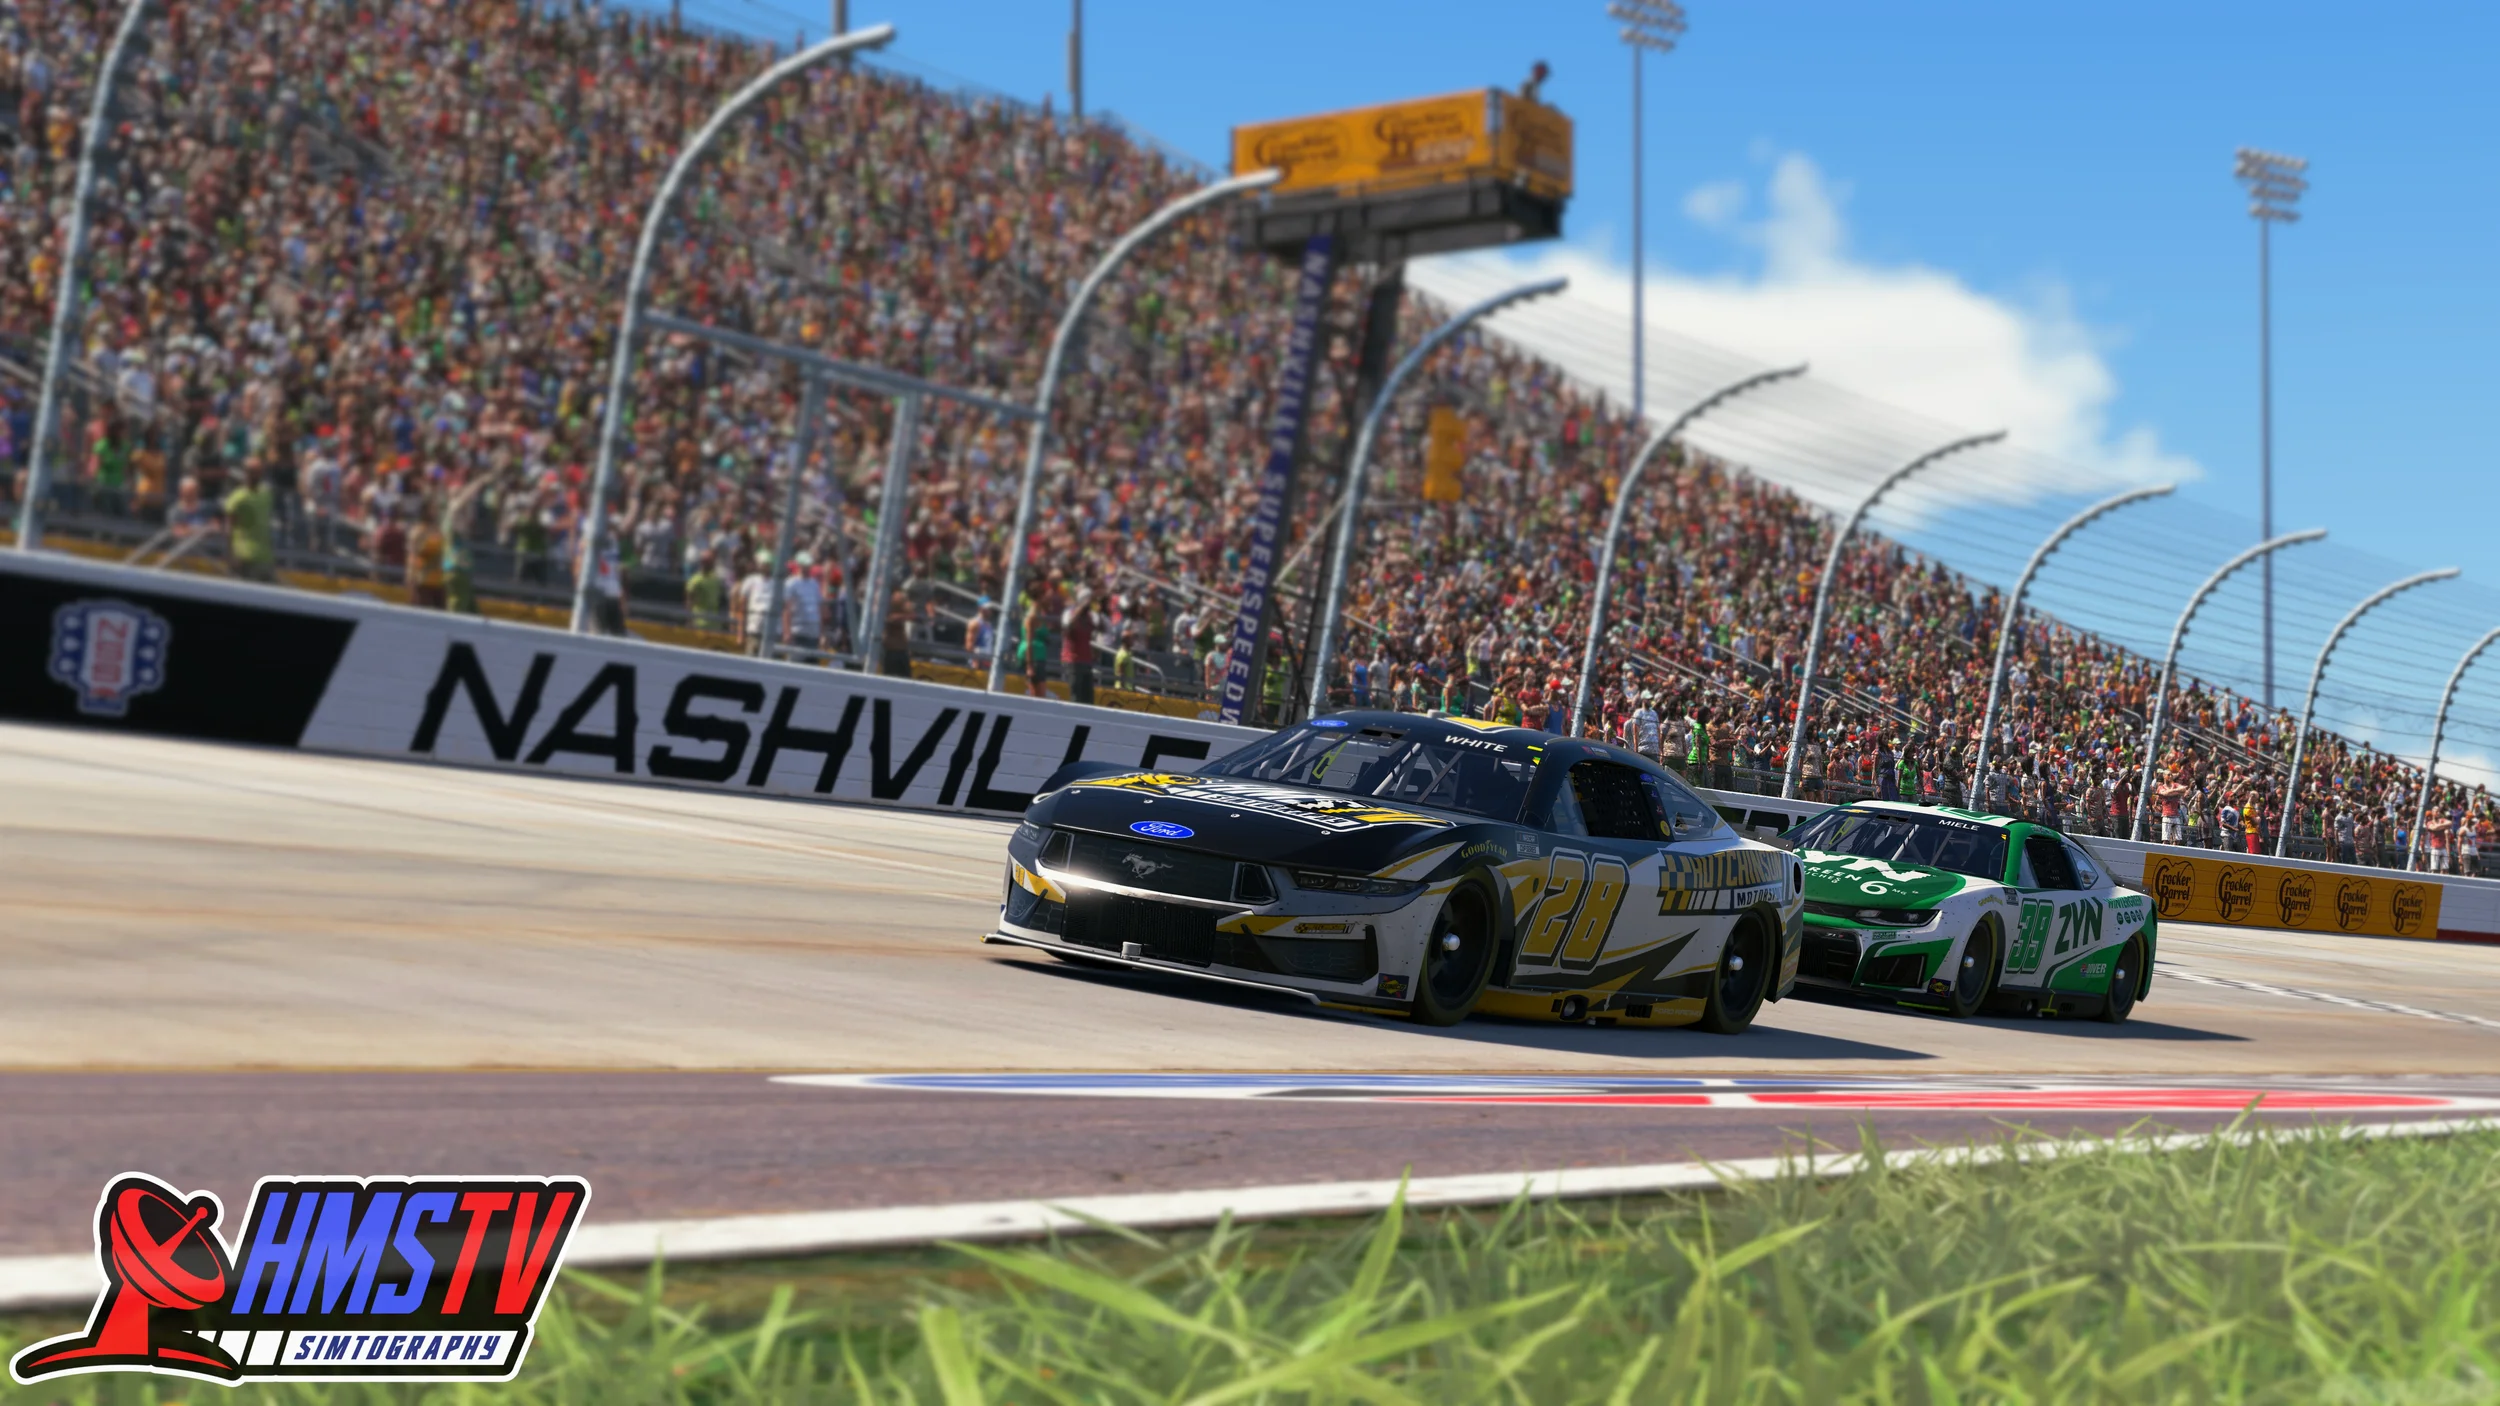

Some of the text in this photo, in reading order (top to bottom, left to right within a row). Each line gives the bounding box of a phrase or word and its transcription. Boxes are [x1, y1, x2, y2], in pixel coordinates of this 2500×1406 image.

[1445, 735, 1508, 753] WHITE
[1139, 821, 1185, 837] Ford
[1938, 819, 1980, 831] MIELE
[1461, 839, 1508, 858] GOODYEAR
[1860, 880, 1894, 895] 6
[2155, 865, 2191, 894] Cracker
[2219, 872, 2253, 901] Cracker
[2279, 878, 2312, 907] Cracker
[1517, 848, 1630, 972] 28
[2158, 885, 2190, 912] Barrel
[2221, 891, 2252, 918] Barrel
[2281, 897, 2311, 923] Barrel
[2337, 884, 2368, 911] Cracker
[2392, 889, 2423, 916] Cracker
[2054, 897, 2103, 955] ZYN
[2340, 903, 2368, 928] Barrel
[2394, 908, 2422, 932] Barrel
[2005, 898, 2054, 974] 39
